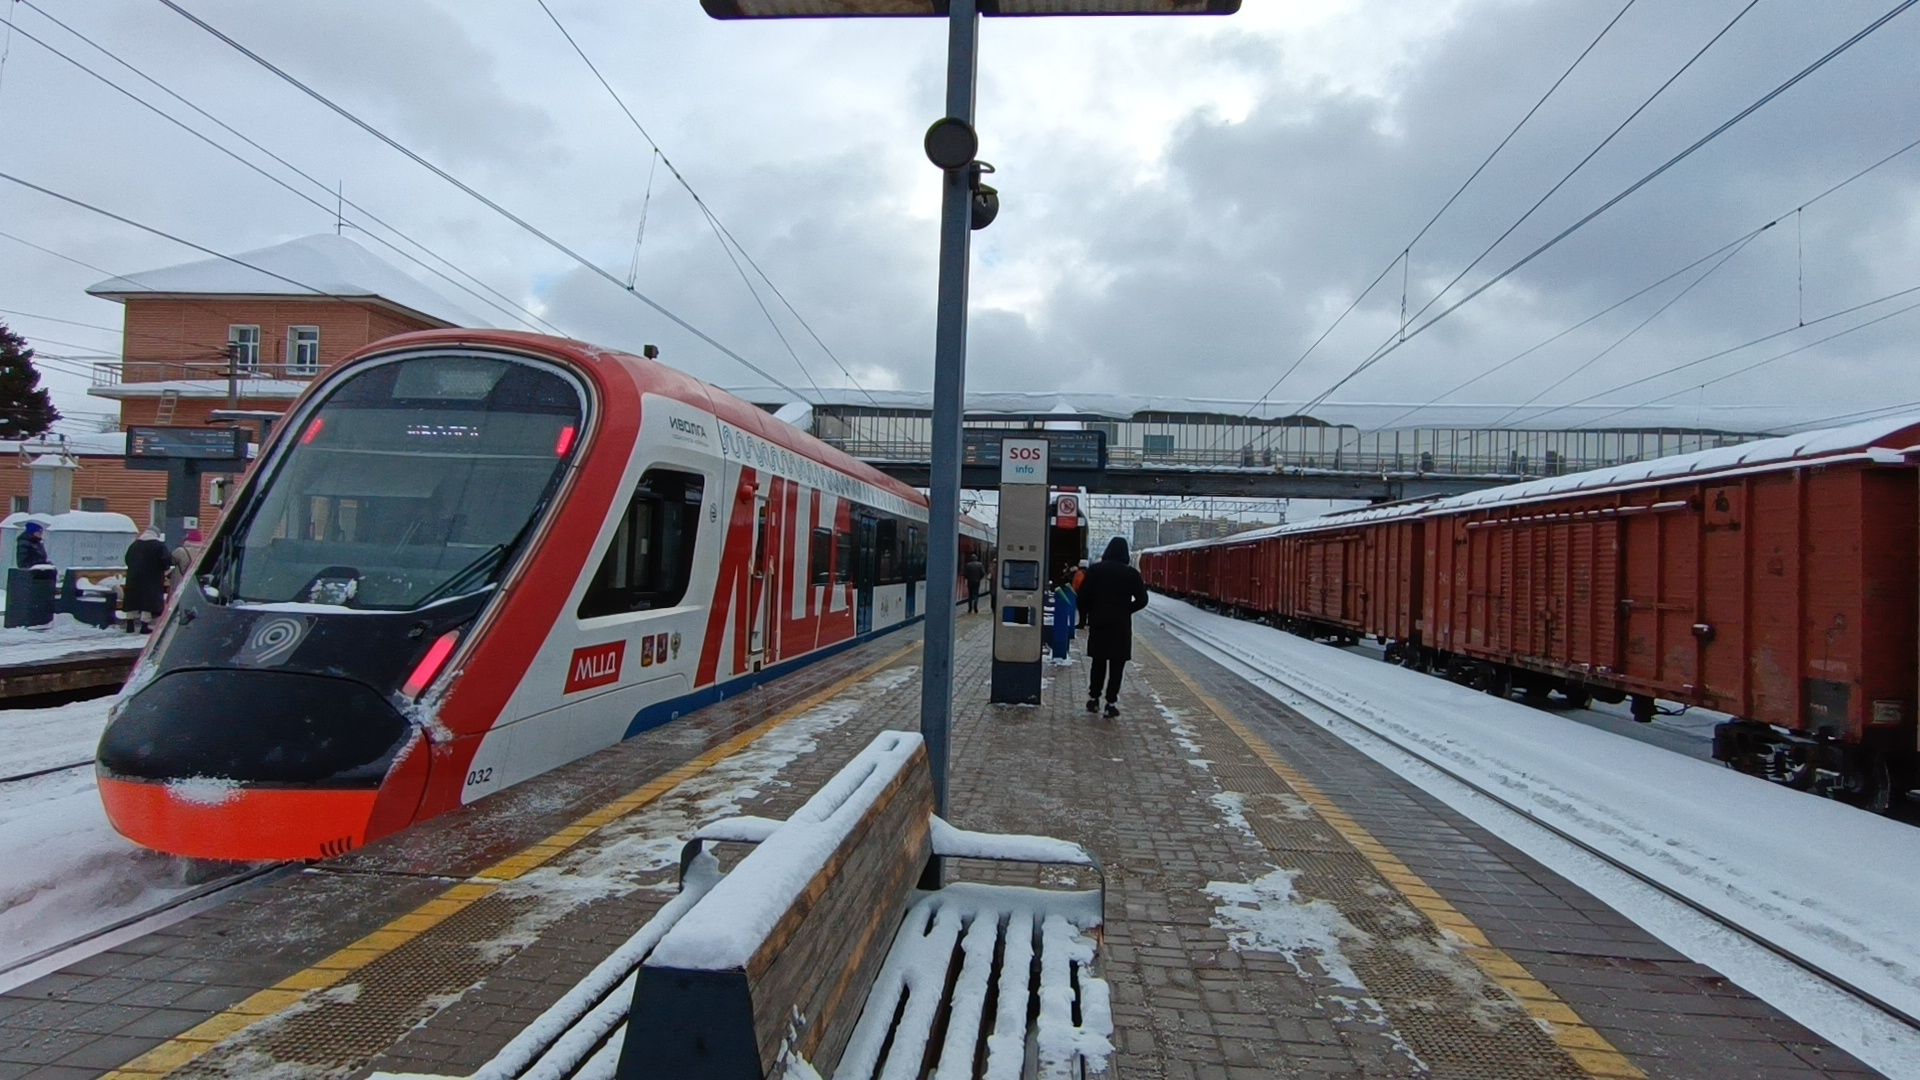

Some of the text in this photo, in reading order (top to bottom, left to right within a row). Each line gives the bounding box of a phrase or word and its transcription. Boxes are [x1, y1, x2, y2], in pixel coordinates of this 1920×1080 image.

[669, 416, 708, 439] ИВОЛГА
[1009, 447, 1041, 460] SOS
[1015, 465, 1034, 474] info
[694, 464, 857, 688] МЦД
[574, 651, 617, 682] МЦД
[467, 767, 493, 785] 032
